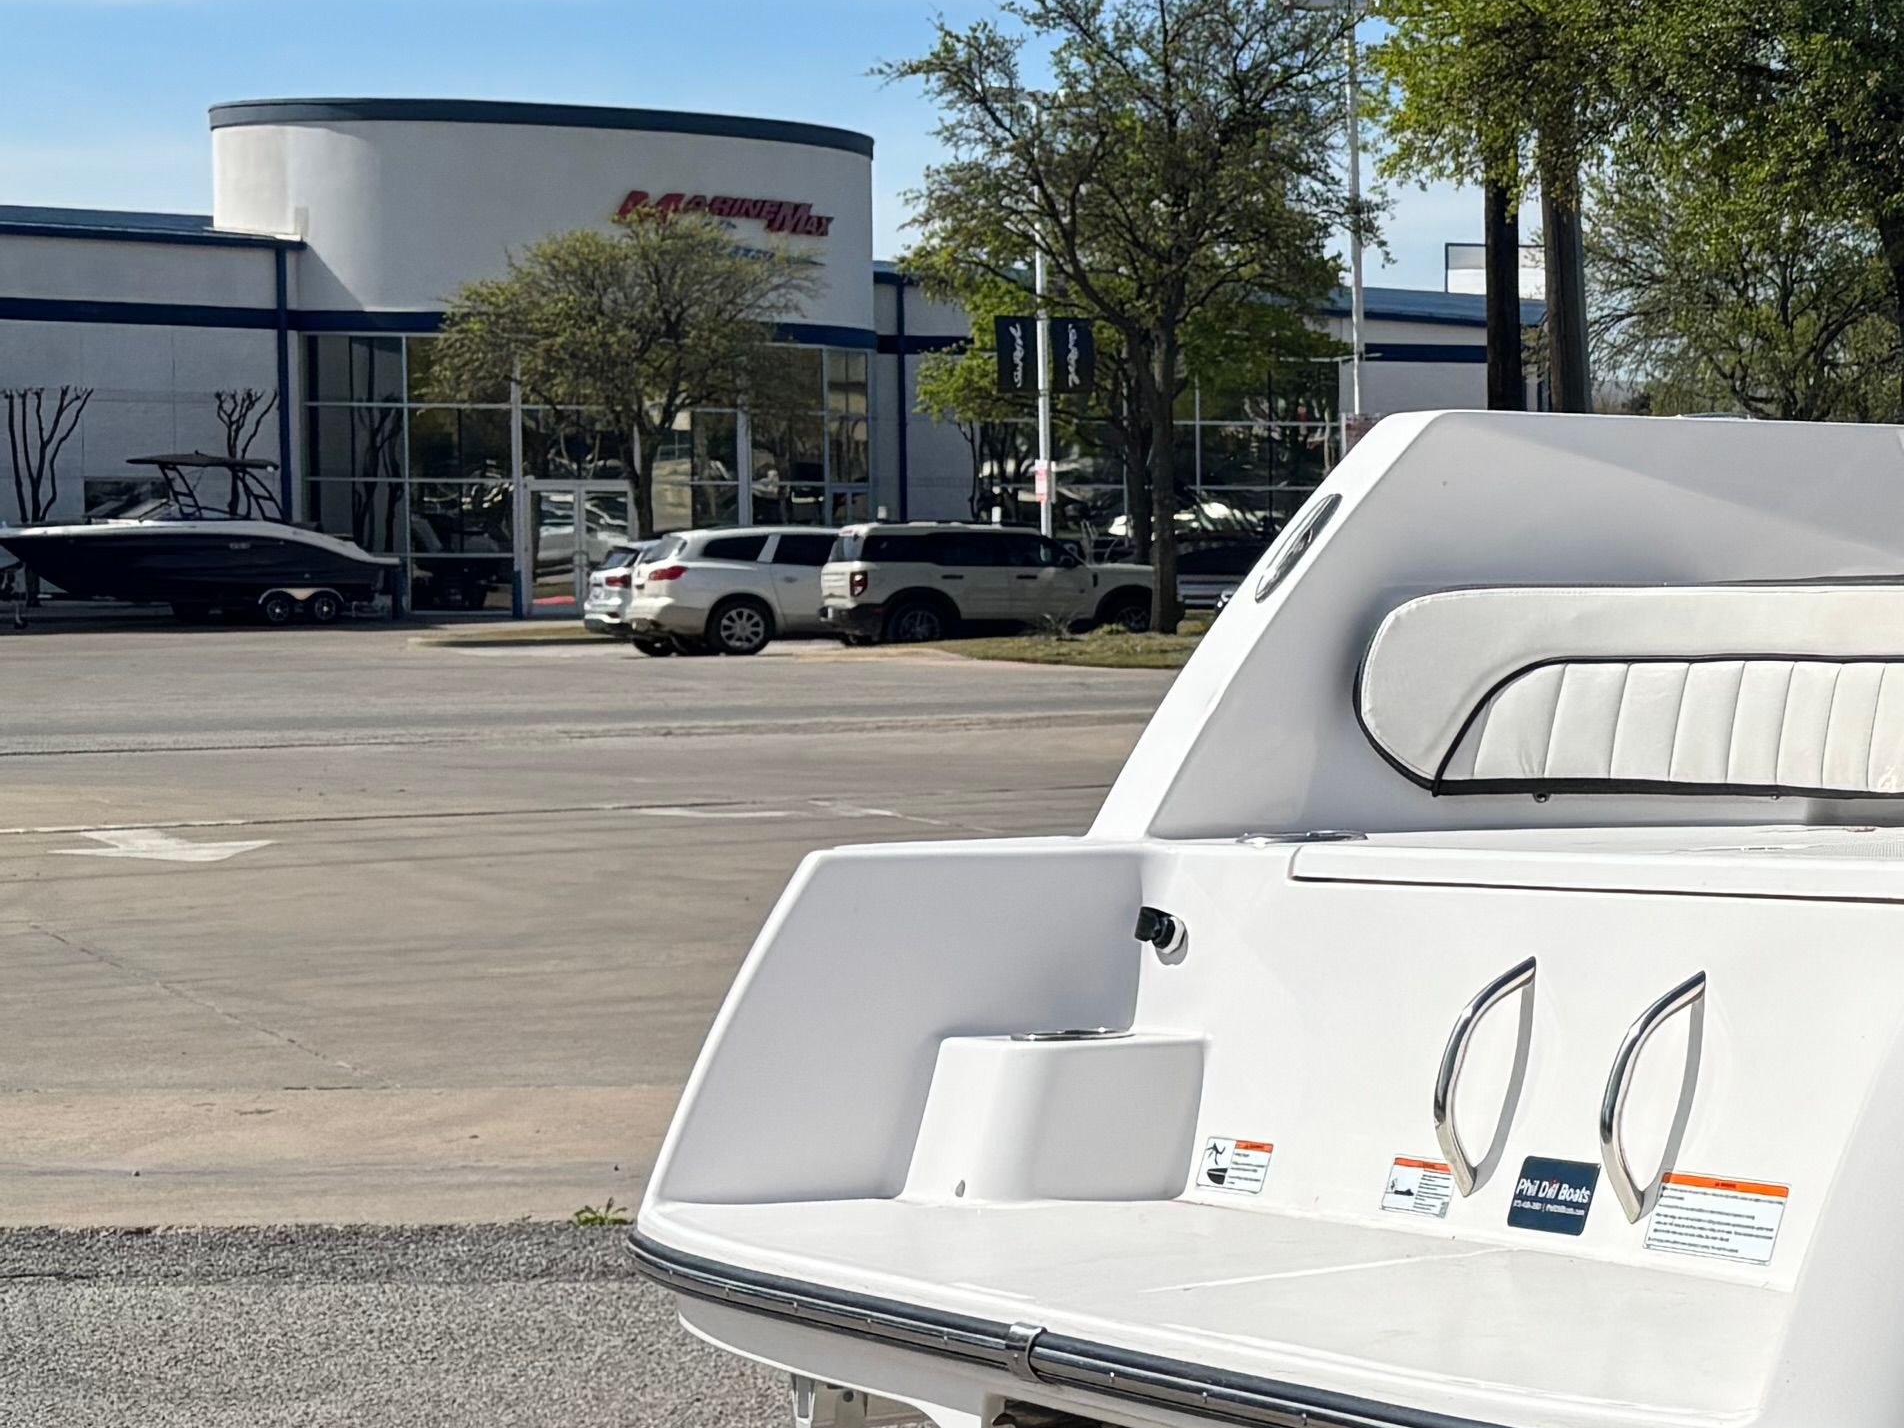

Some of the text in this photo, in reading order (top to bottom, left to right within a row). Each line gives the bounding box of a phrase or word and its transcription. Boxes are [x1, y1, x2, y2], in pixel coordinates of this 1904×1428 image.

[1516, 1178, 1591, 1203] Phil Dill Boats
